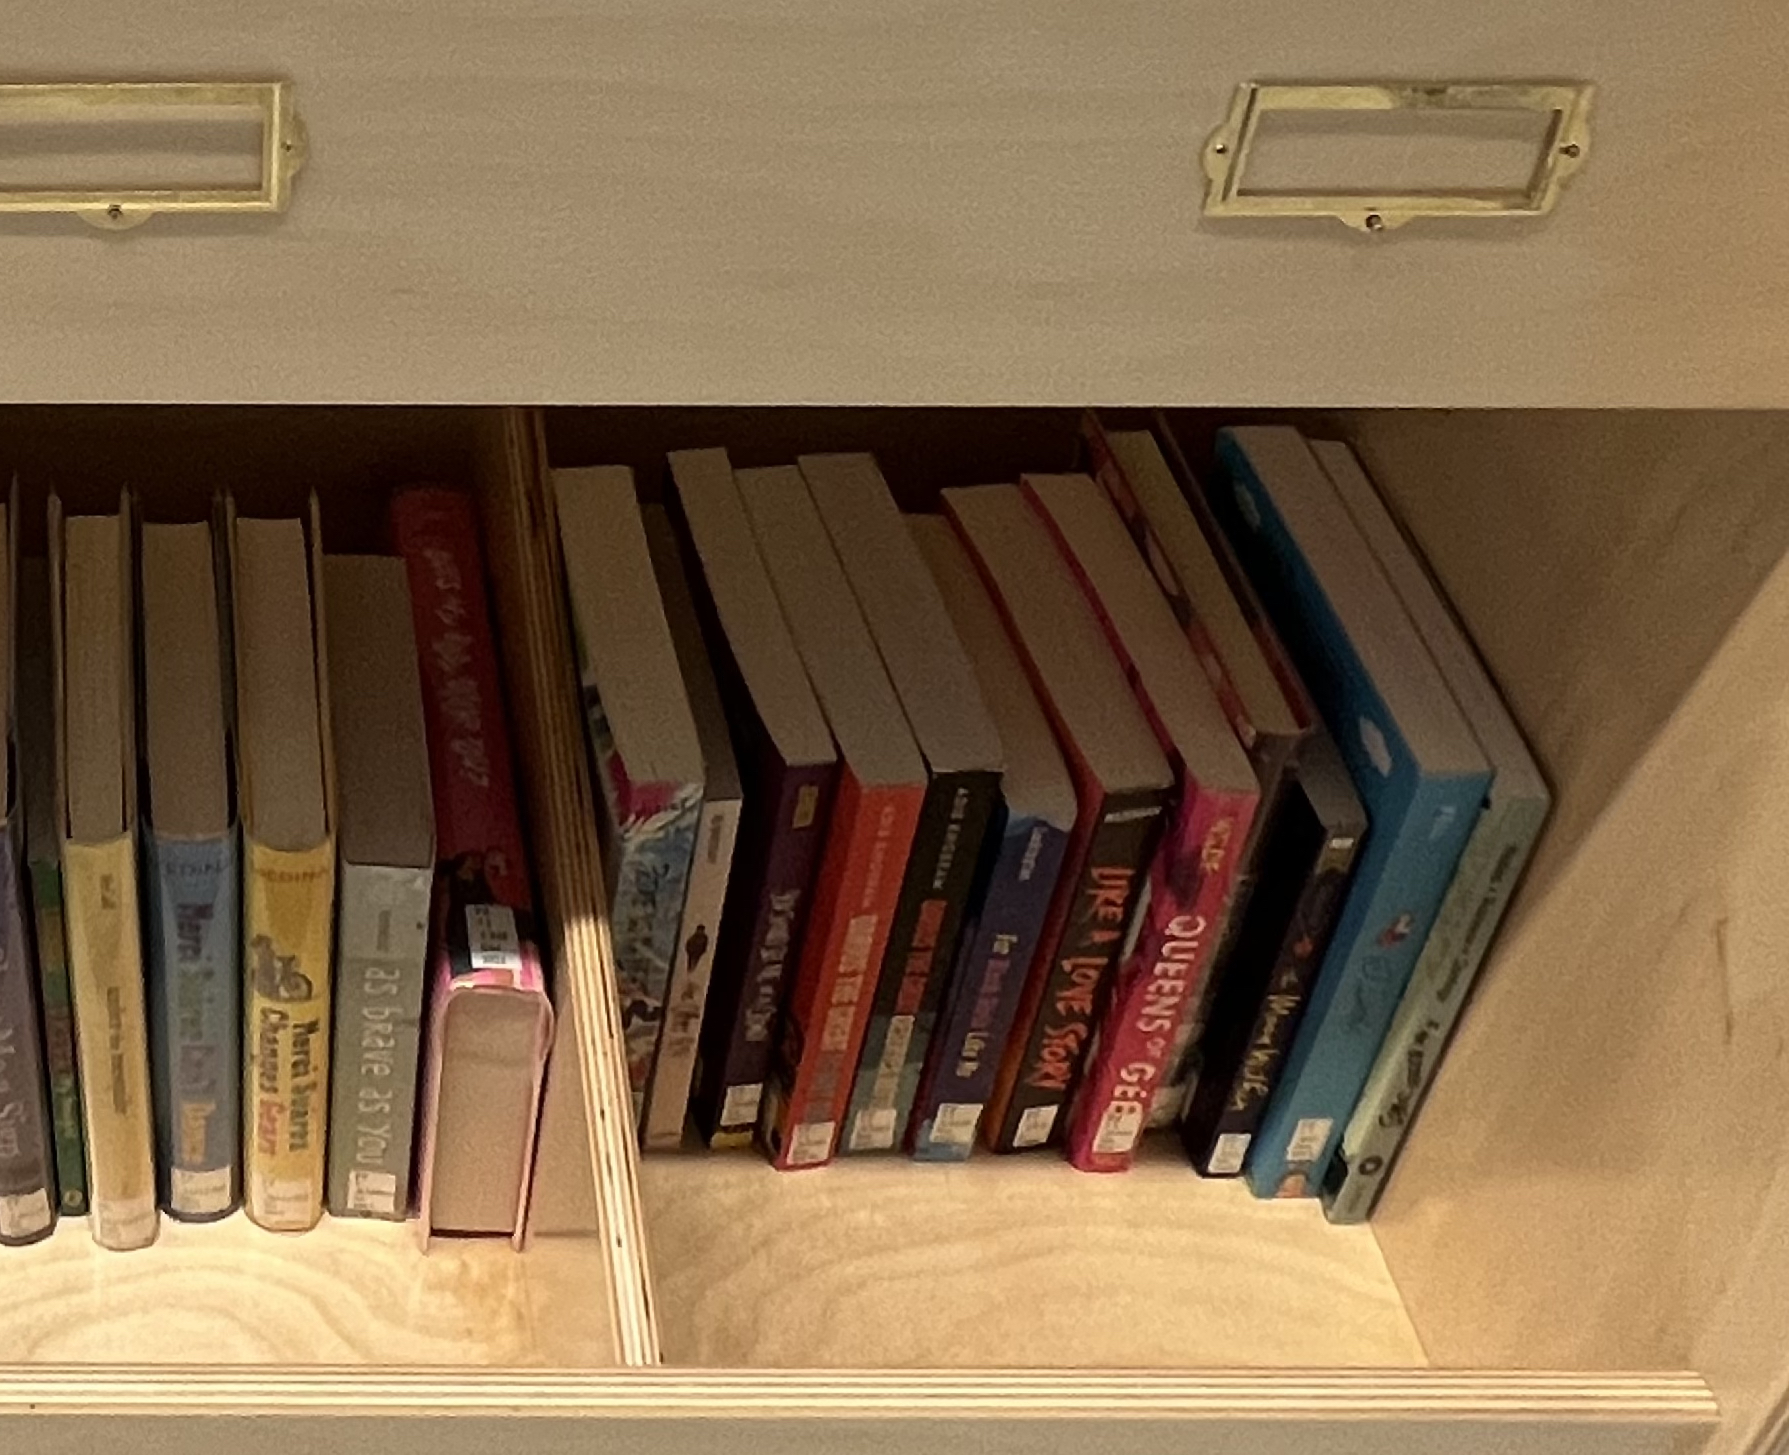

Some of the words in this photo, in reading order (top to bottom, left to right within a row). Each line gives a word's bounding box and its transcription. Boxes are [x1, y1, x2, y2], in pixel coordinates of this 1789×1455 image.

[364, 966, 400, 997] as
[1136, 914, 1207, 1034] QUEENS
[359, 1089, 393, 1115] as
[1112, 1061, 1158, 1117] GEE
